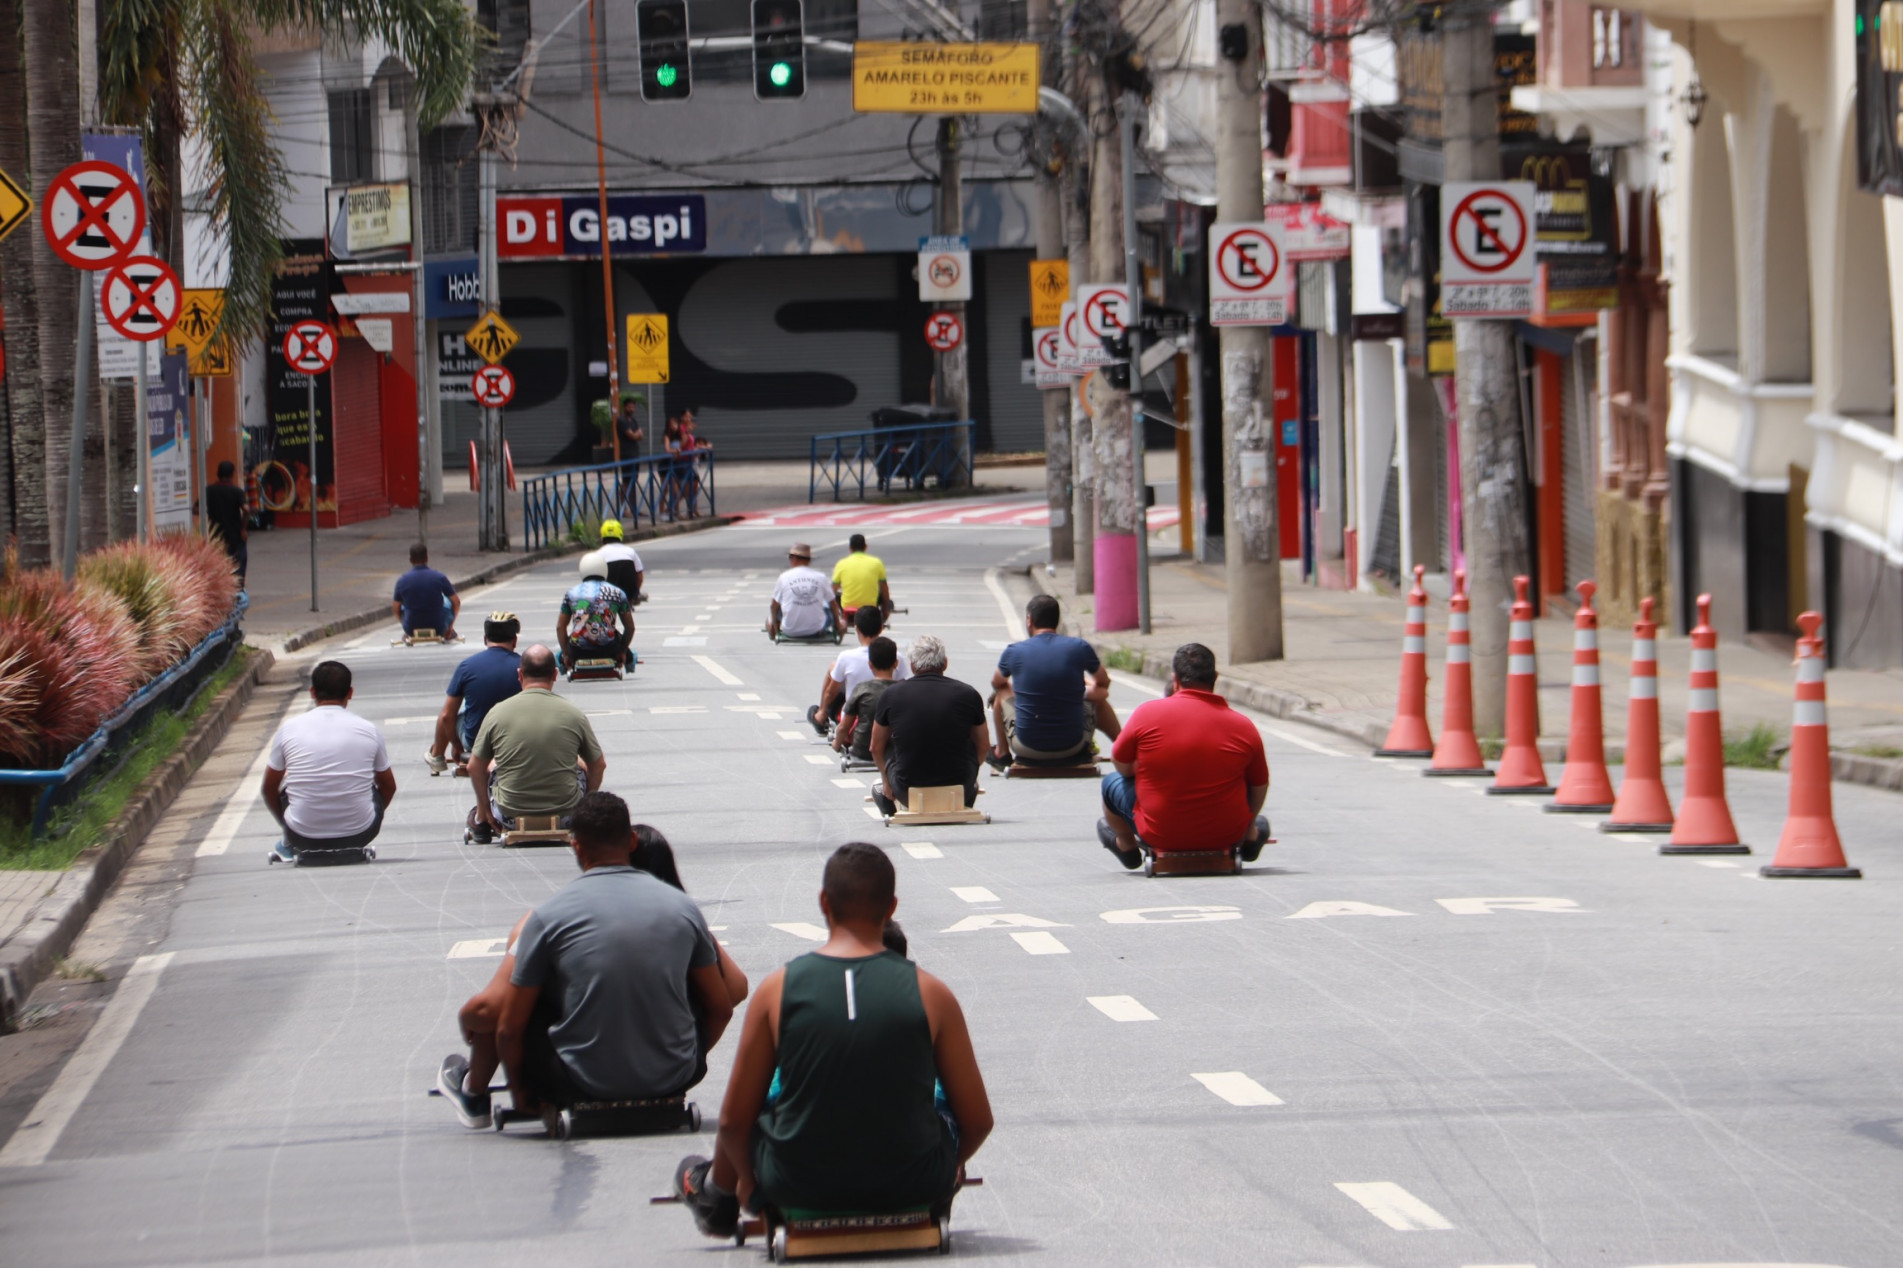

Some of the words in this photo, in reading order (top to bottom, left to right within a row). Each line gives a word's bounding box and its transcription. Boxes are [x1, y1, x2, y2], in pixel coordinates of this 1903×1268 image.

[864, 70, 944, 86] AMARELO
[949, 71, 1030, 86] PISCANTE
[910, 90, 936, 105] 23h
[964, 89, 982, 104] 5h
[506, 209, 558, 244] Di
[569, 205, 691, 248] Gaspi
[276, 290, 295, 300] AQUI
[296, 288, 316, 300] VOCÊ
[280, 307, 313, 317] COMPRA
[286, 381, 318, 390] SACOA
